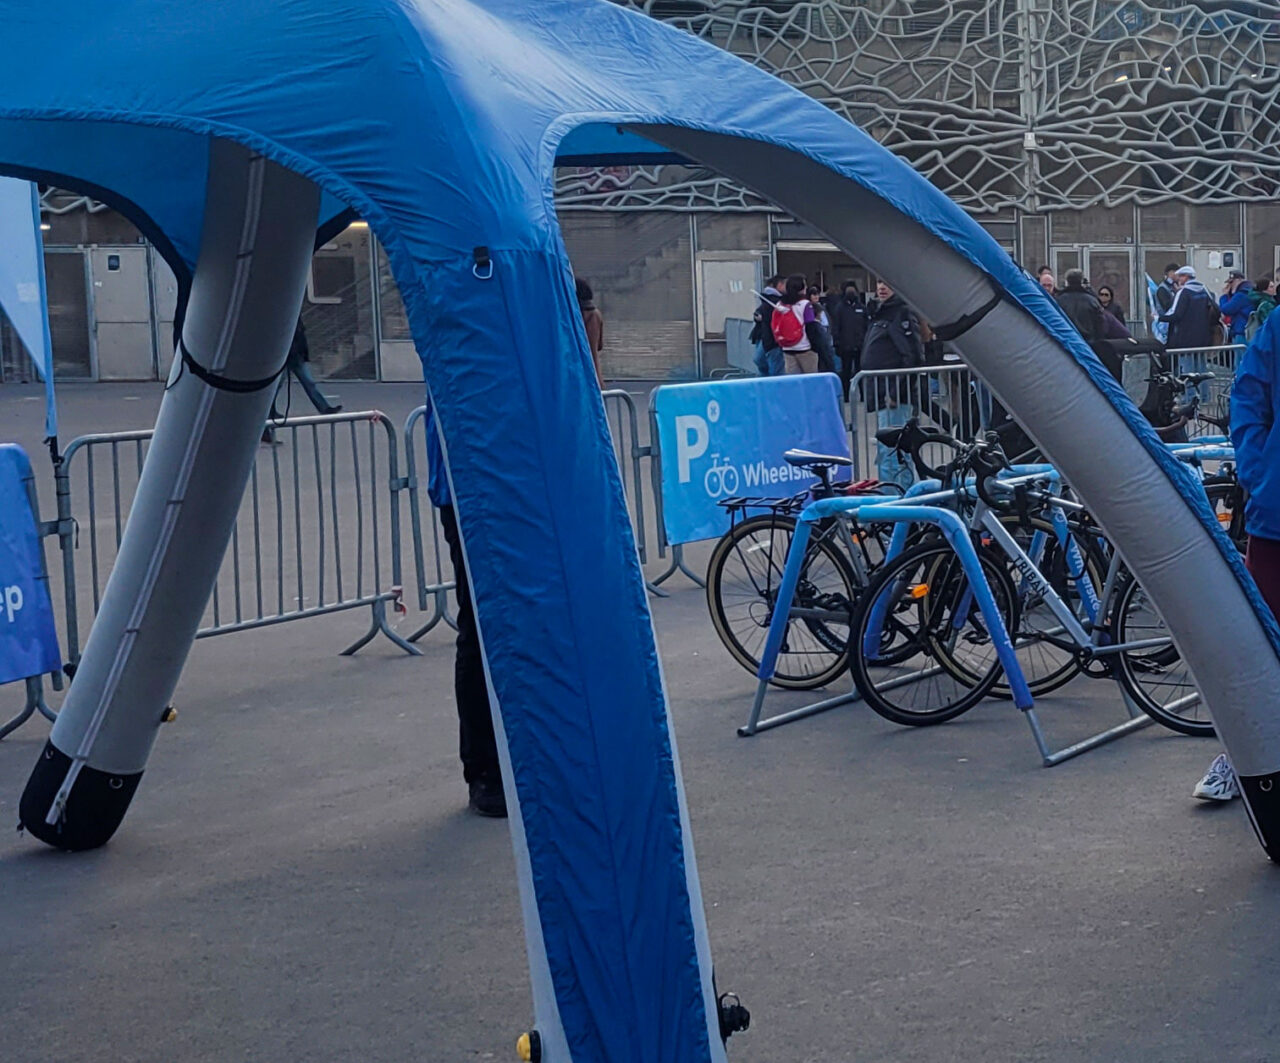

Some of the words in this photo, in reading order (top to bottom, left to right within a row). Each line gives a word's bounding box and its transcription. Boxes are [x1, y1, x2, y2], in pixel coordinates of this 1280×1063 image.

[675, 414, 709, 484] P
[742, 460, 839, 487] Wheelsp
[1012, 553, 1050, 598] TRIBAN
